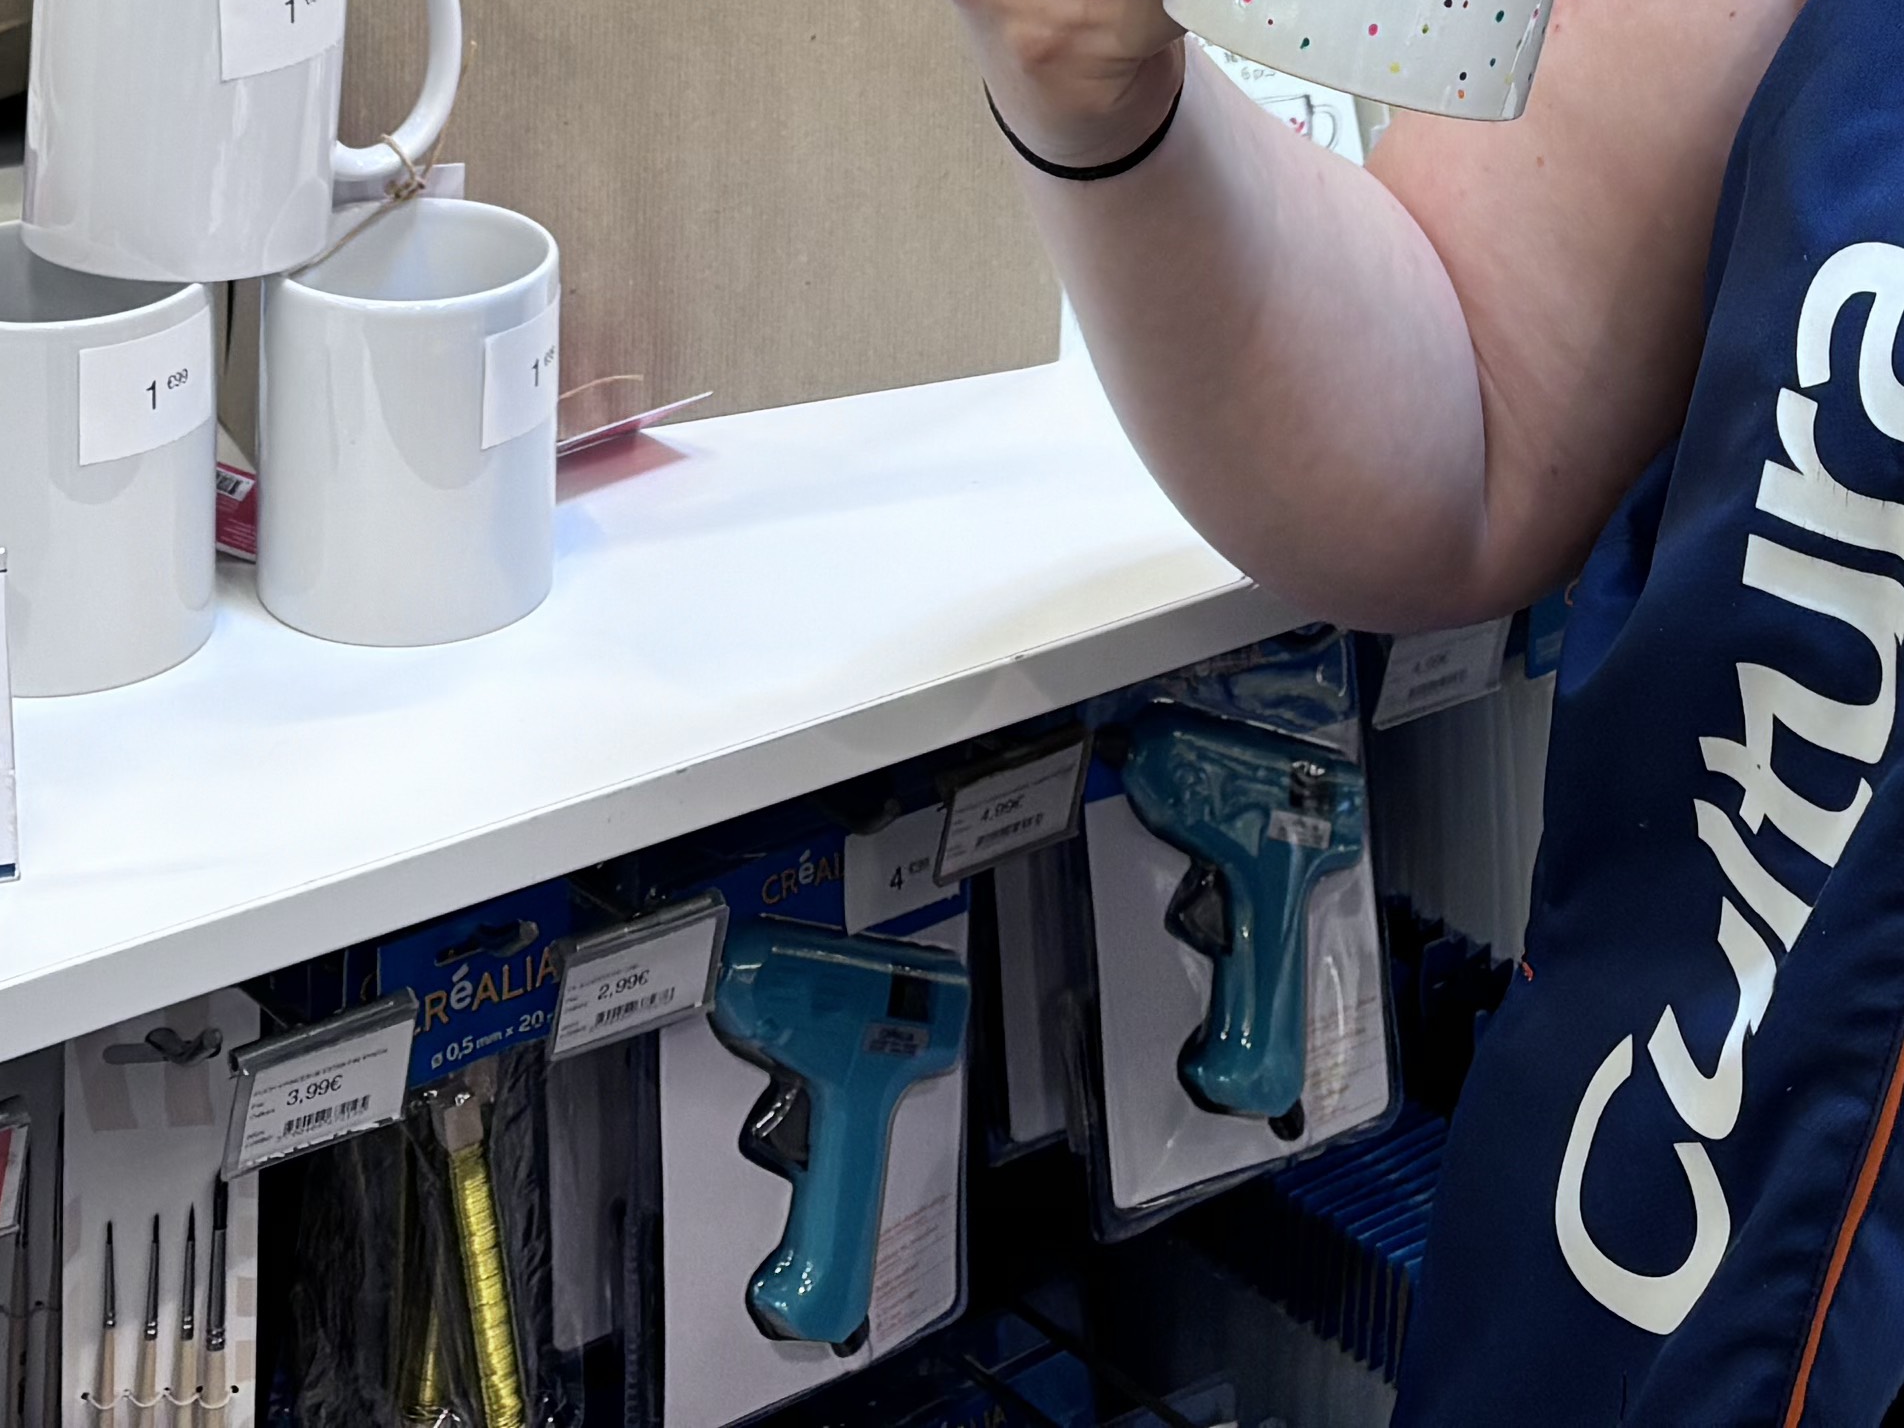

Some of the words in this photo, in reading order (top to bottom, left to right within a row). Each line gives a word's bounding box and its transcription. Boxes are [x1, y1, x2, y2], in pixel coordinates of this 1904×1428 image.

[146, 380, 162, 411] 1
[166, 367, 190, 391] €99
[530, 358, 540, 387] 1
[889, 865, 905, 891] 4
[414, 945, 560, 1035] RéALIA
